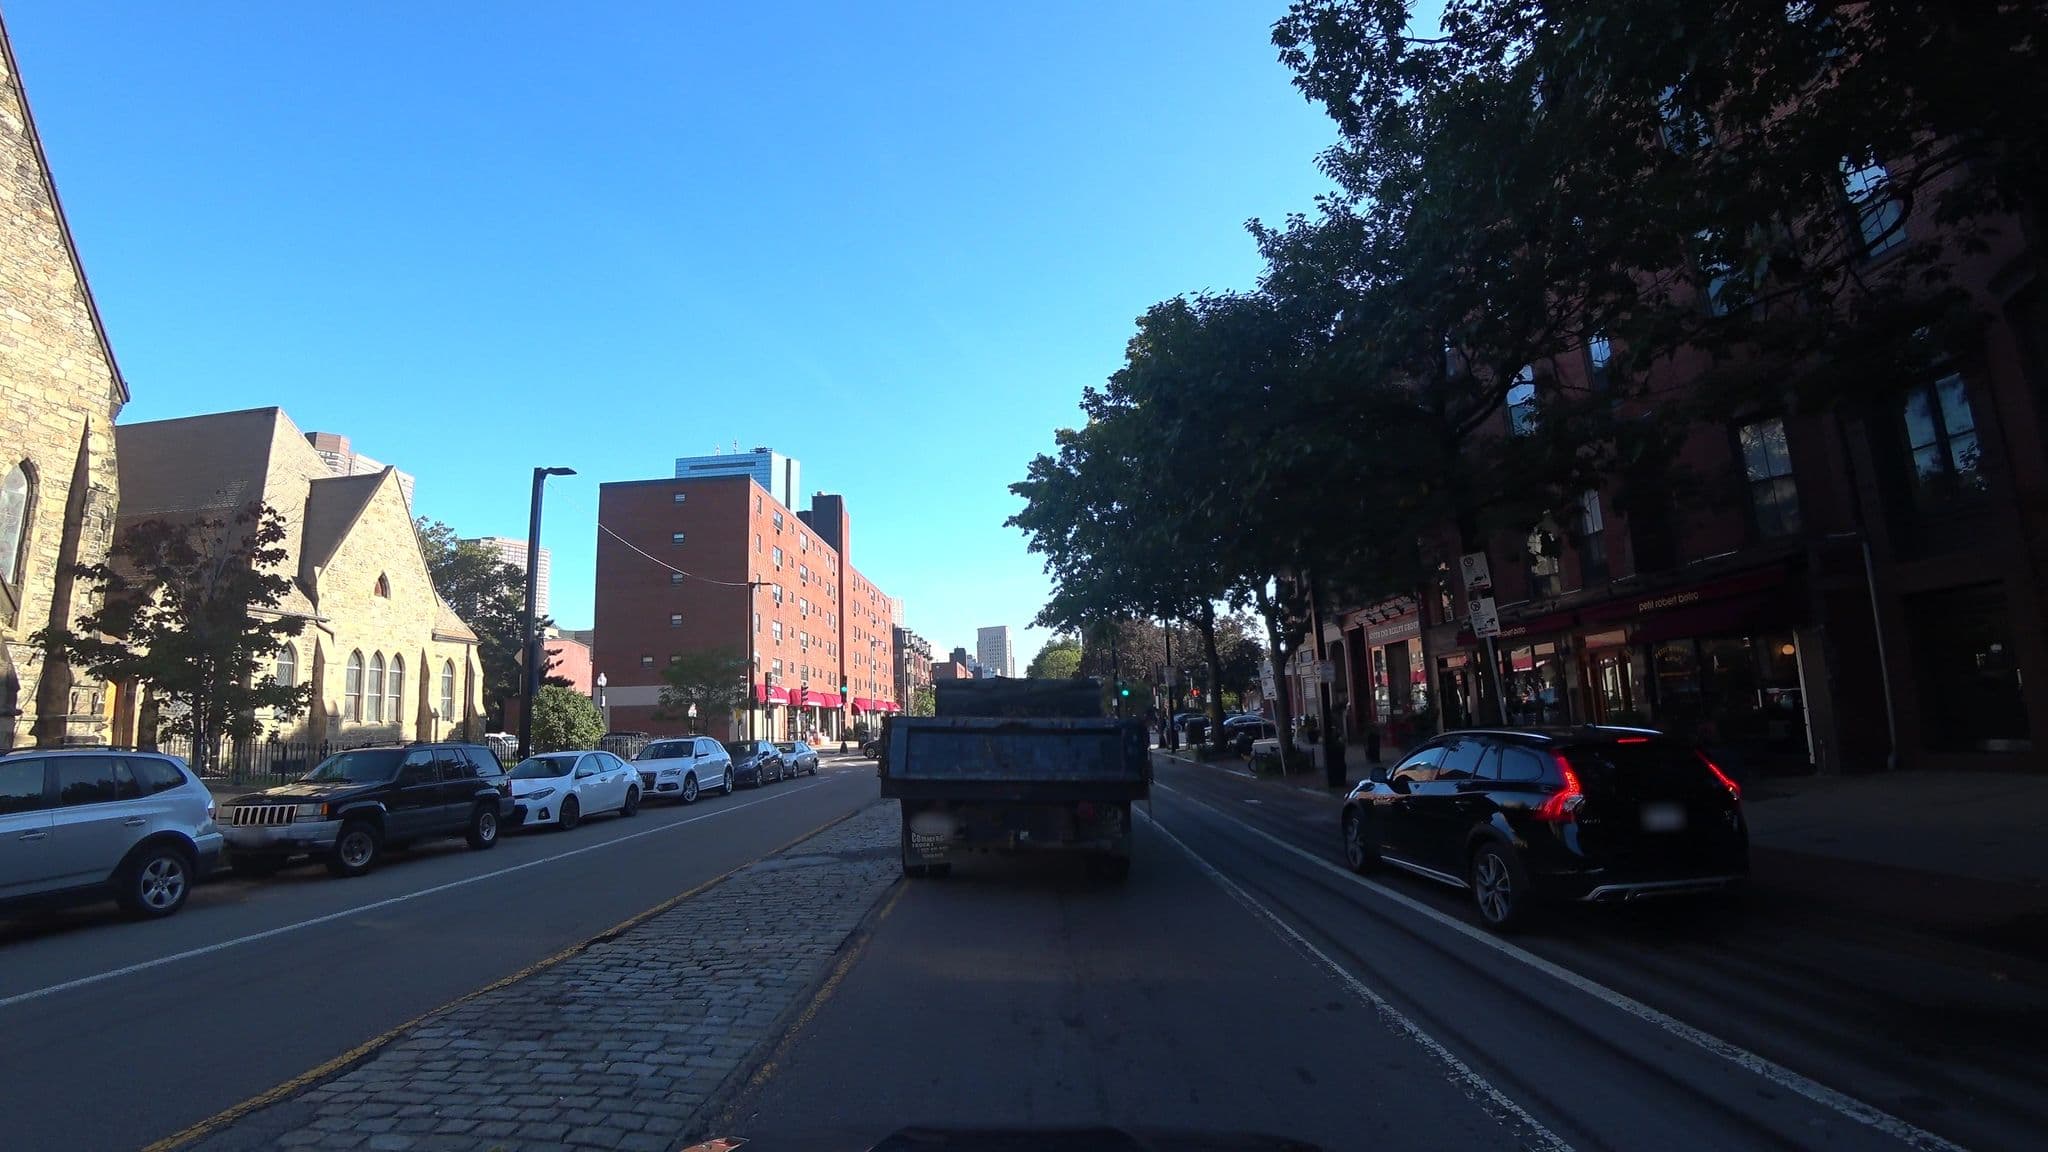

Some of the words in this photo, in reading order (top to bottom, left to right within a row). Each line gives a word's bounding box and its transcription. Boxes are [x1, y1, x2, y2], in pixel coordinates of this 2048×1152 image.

[1638, 599, 1654, 613] petit
[1655, 595, 1677, 608] robert
[1678, 591, 1699, 603] bistro
